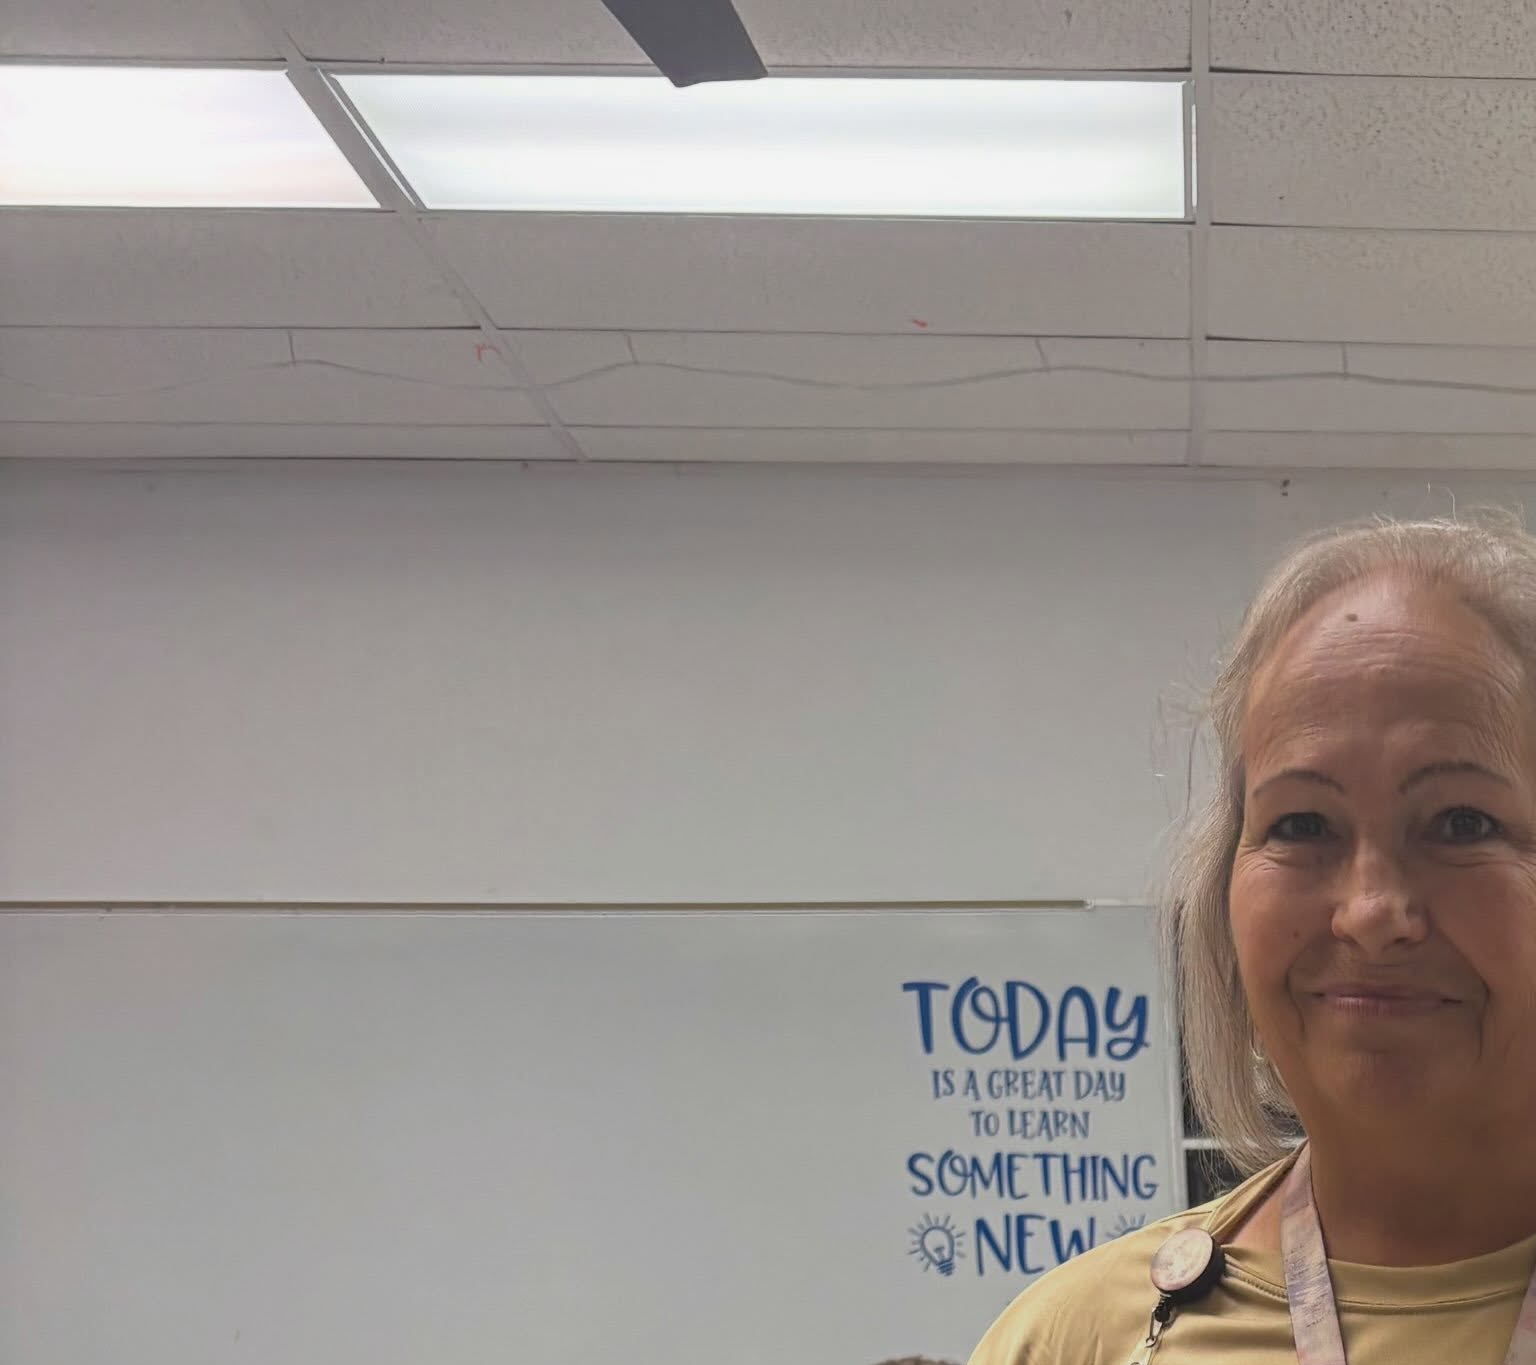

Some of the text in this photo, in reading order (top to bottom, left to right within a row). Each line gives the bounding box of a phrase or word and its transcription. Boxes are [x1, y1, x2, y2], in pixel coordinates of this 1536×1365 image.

[902, 976, 1151, 1062] TODAY
[931, 1069, 1127, 1102] IS A GREAT DAY
[970, 1109, 1091, 1142] TO LEARN
[906, 1149, 1160, 1205] SOMETHING
[975, 1212, 1096, 1277] NEW
